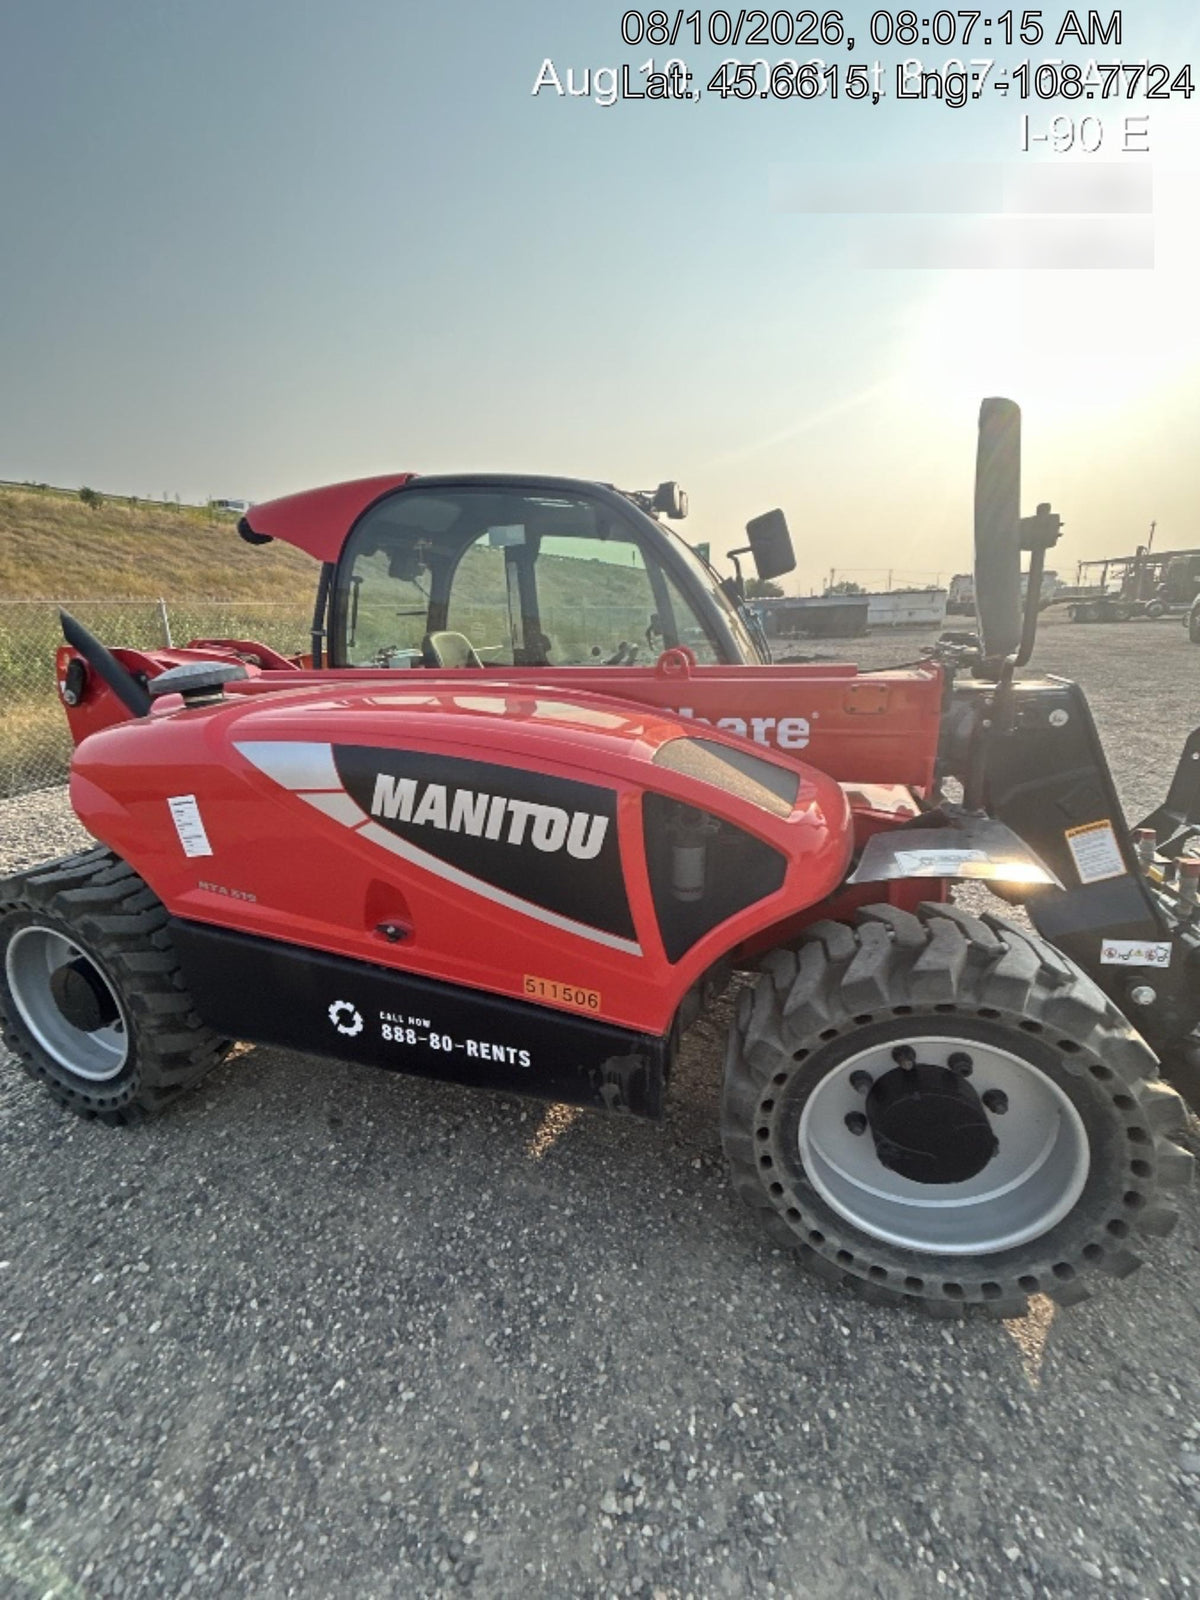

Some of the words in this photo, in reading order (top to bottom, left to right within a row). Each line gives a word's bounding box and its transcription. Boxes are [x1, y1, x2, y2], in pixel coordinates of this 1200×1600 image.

[370, 773, 609, 860] MANITOU
[525, 978, 598, 1009] 511506
[380, 1010, 404, 1023] CALL
[408, 1016, 431, 1029] NOW
[381, 1023, 532, 1067] 888-80-RENTS
